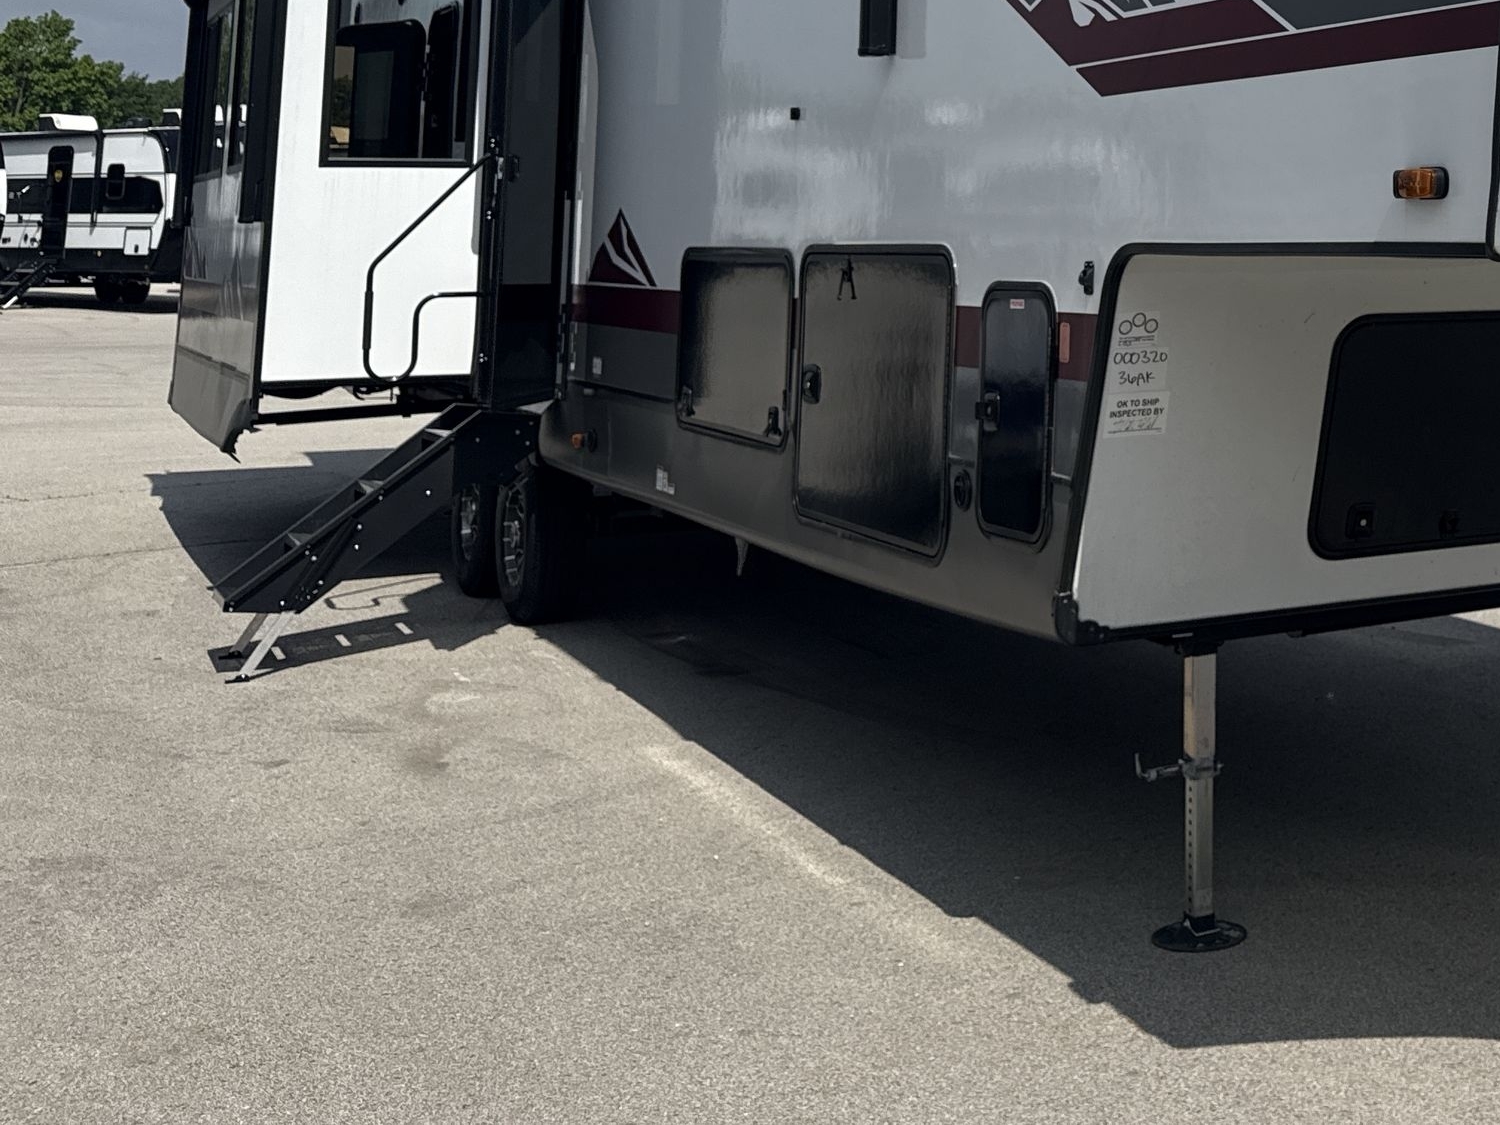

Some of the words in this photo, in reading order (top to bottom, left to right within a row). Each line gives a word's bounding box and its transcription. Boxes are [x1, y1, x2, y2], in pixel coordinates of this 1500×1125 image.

[1113, 349, 1168, 365] 000320
[1116, 400, 1129, 409] OK
[1130, 399, 1141, 408] TO
[1142, 398, 1160, 407] SHIP
[1109, 408, 1153, 419] INSPECTED
[1153, 407, 1165, 416] BY
